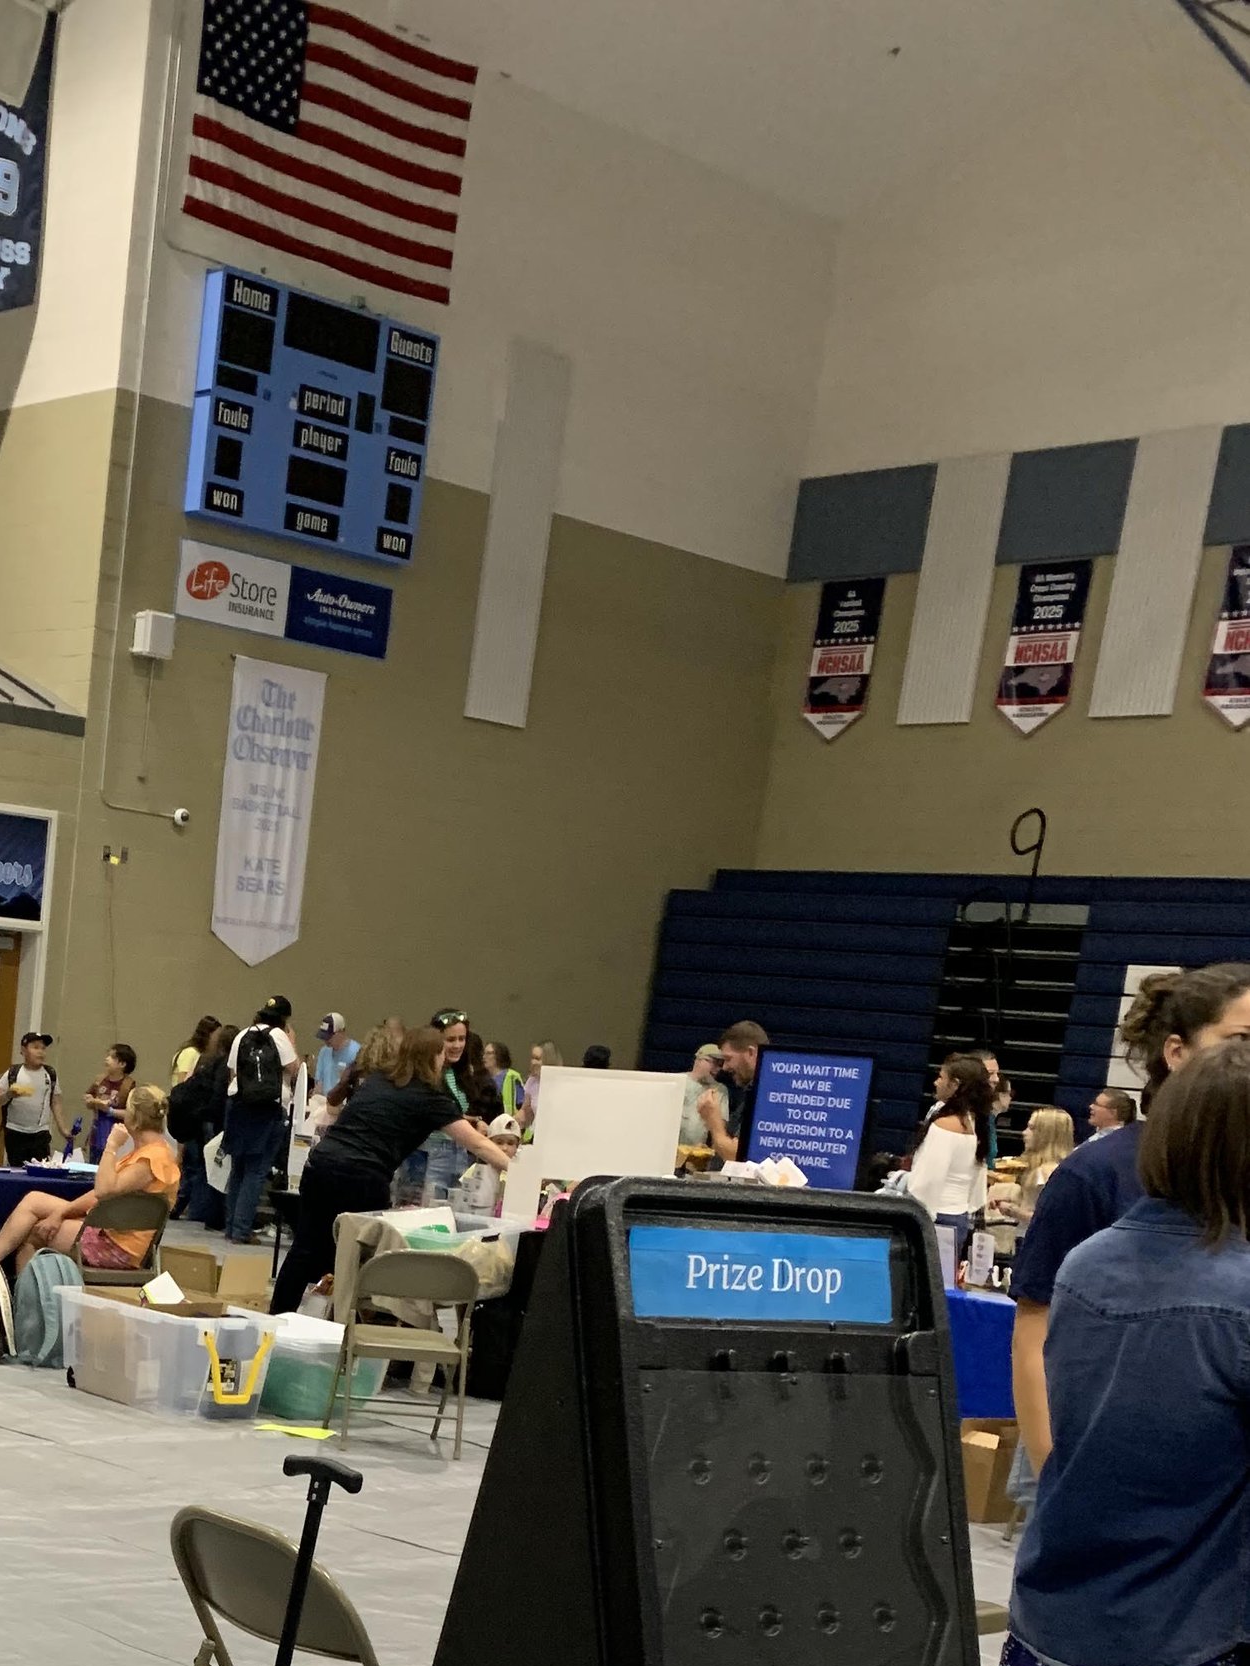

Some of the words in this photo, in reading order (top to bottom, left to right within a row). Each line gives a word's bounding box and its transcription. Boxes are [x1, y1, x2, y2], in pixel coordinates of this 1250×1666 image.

[233, 279, 271, 311] Home
[391, 331, 432, 363] Guests
[304, 390, 346, 418] period
[218, 401, 249, 429] fouls
[301, 426, 342, 453] player
[389, 451, 418, 477] fouls
[213, 489, 238, 511] won
[296, 512, 328, 533] game
[383, 533, 406, 553] won
[190, 566, 226, 597] Life
[229, 572, 278, 607] Store
[228, 601, 275, 621] INSURANCE
[1032, 605, 1065, 619] 2025
[1014, 640, 1068, 664] NCHSAA
[771, 1062, 801, 1075] YOUR
[803, 1065, 831, 1077] WAIT
[833, 1067, 860, 1079] TIME
[791, 1080, 815, 1091] MAY
[817, 1081, 832, 1092] BE
[769, 1092, 825, 1107] EXTENDED
[827, 1097, 851, 1110] DUE
[787, 1108, 801, 1120] TO
[803, 1110, 828, 1122] OUR
[757, 1120, 827, 1138] CONVERSION
[829, 1127, 844, 1139] TO
[845, 1130, 854, 1140] A
[759, 1136, 785, 1148] NEW
[786, 1139, 847, 1155] COMPUTER
[686, 1254, 763, 1291] Prize
[771, 1258, 842, 1304] Drop
